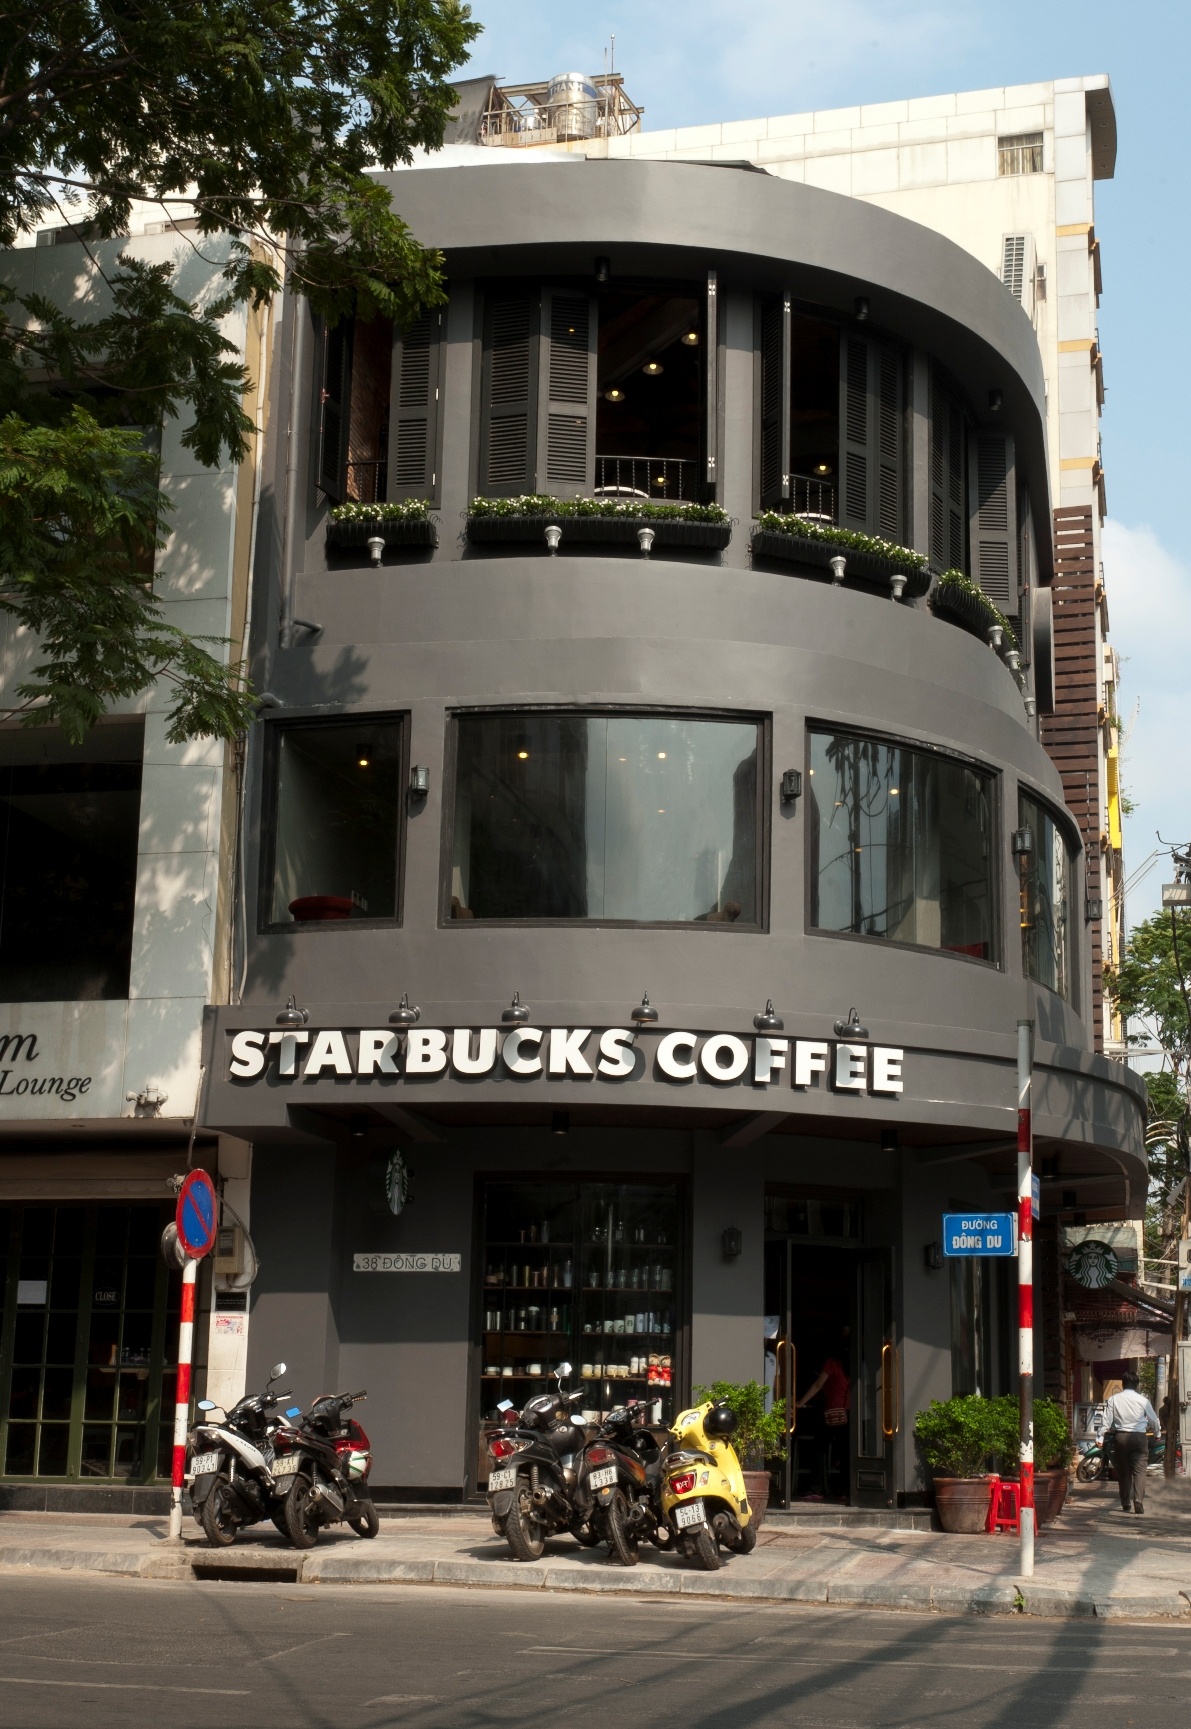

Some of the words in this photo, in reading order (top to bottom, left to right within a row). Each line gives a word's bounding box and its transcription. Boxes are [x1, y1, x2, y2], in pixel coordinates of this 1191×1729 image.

[229, 1027, 637, 1077] STARBUCKS
[656, 1031, 904, 1093] COFFEE
[0, 1070, 92, 1101] Lounge
[952, 1232, 982, 1249] ĐÔNG
[986, 1235, 1002, 1249] DU
[362, 1257, 378, 1270] 38
[431, 1257, 452, 1270] DU
